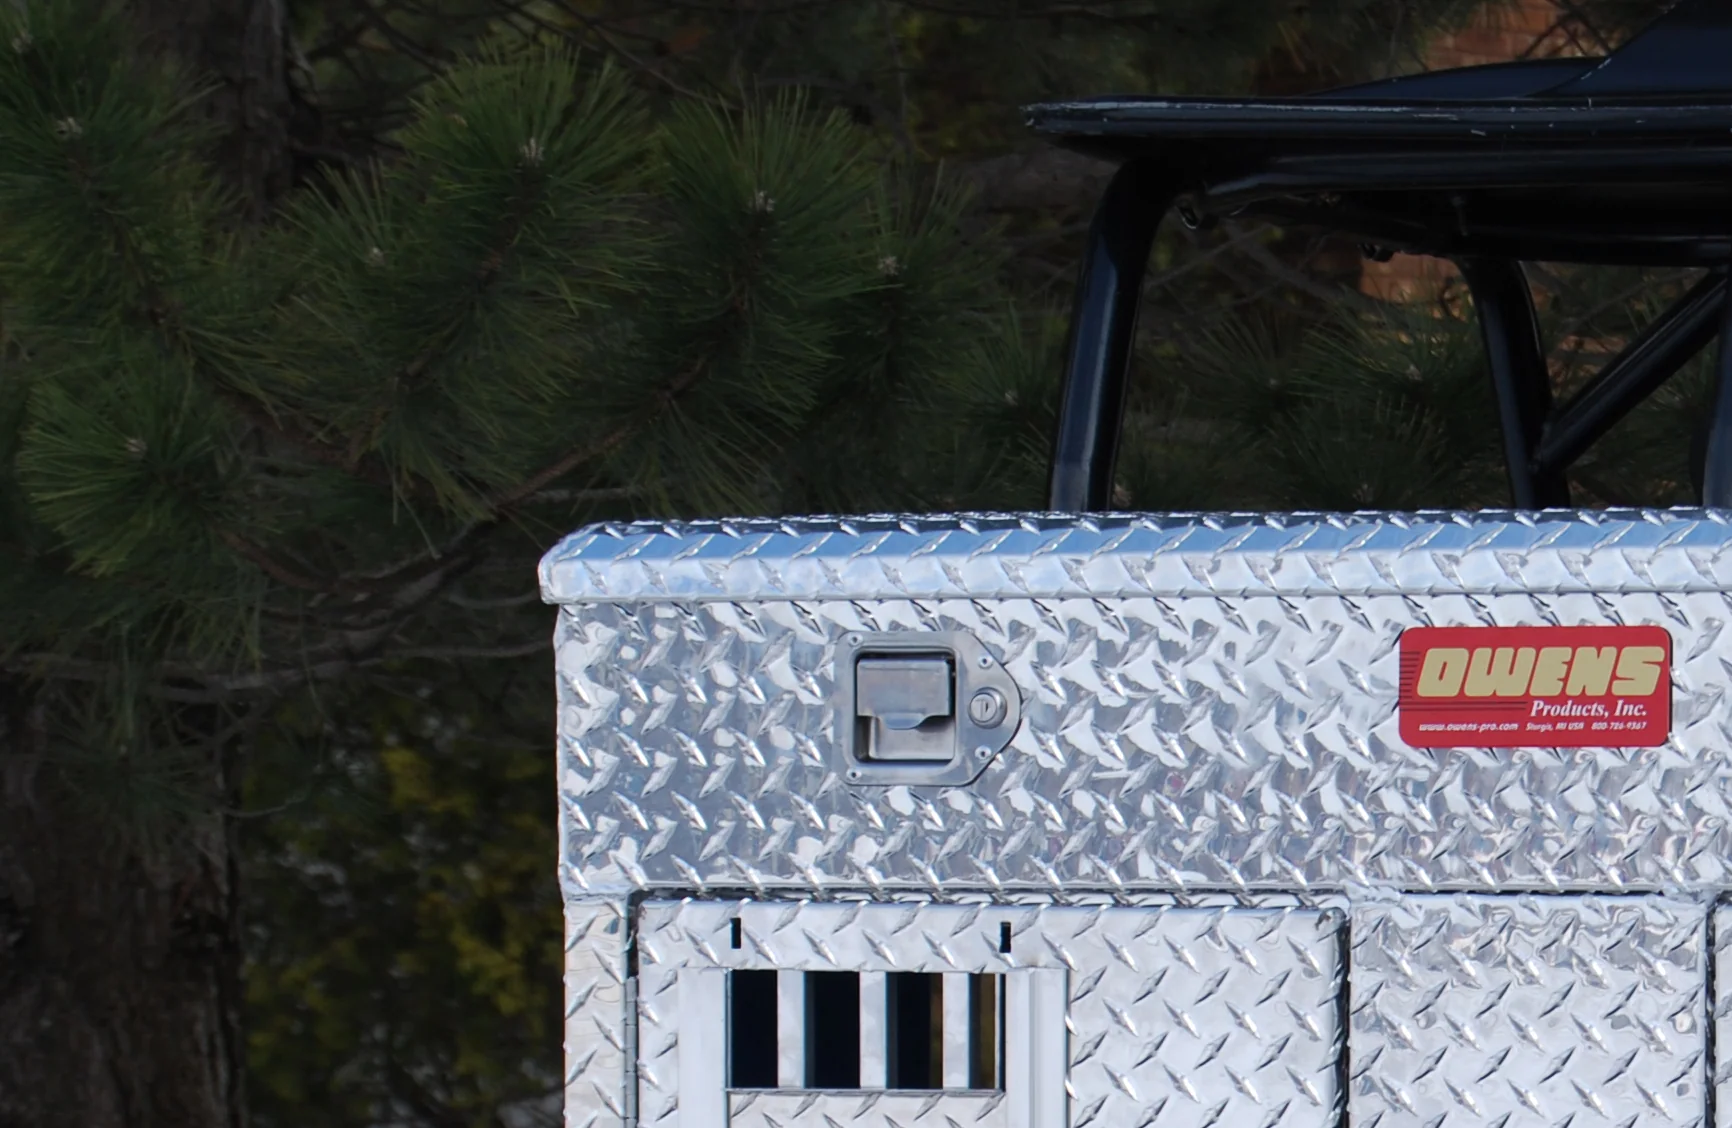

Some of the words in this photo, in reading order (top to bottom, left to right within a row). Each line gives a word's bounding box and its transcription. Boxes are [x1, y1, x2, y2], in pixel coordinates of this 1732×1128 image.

[1417, 646, 1665, 697] OWENS
[1530, 700, 1608, 718] Products,
[1614, 700, 1647, 716] Inc.
[1418, 722, 1518, 733] www.owens-pro.com
[1555, 721, 1567, 730] MI
[1568, 721, 1584, 730] USA
[1591, 720, 1647, 730] 800-726-9367
